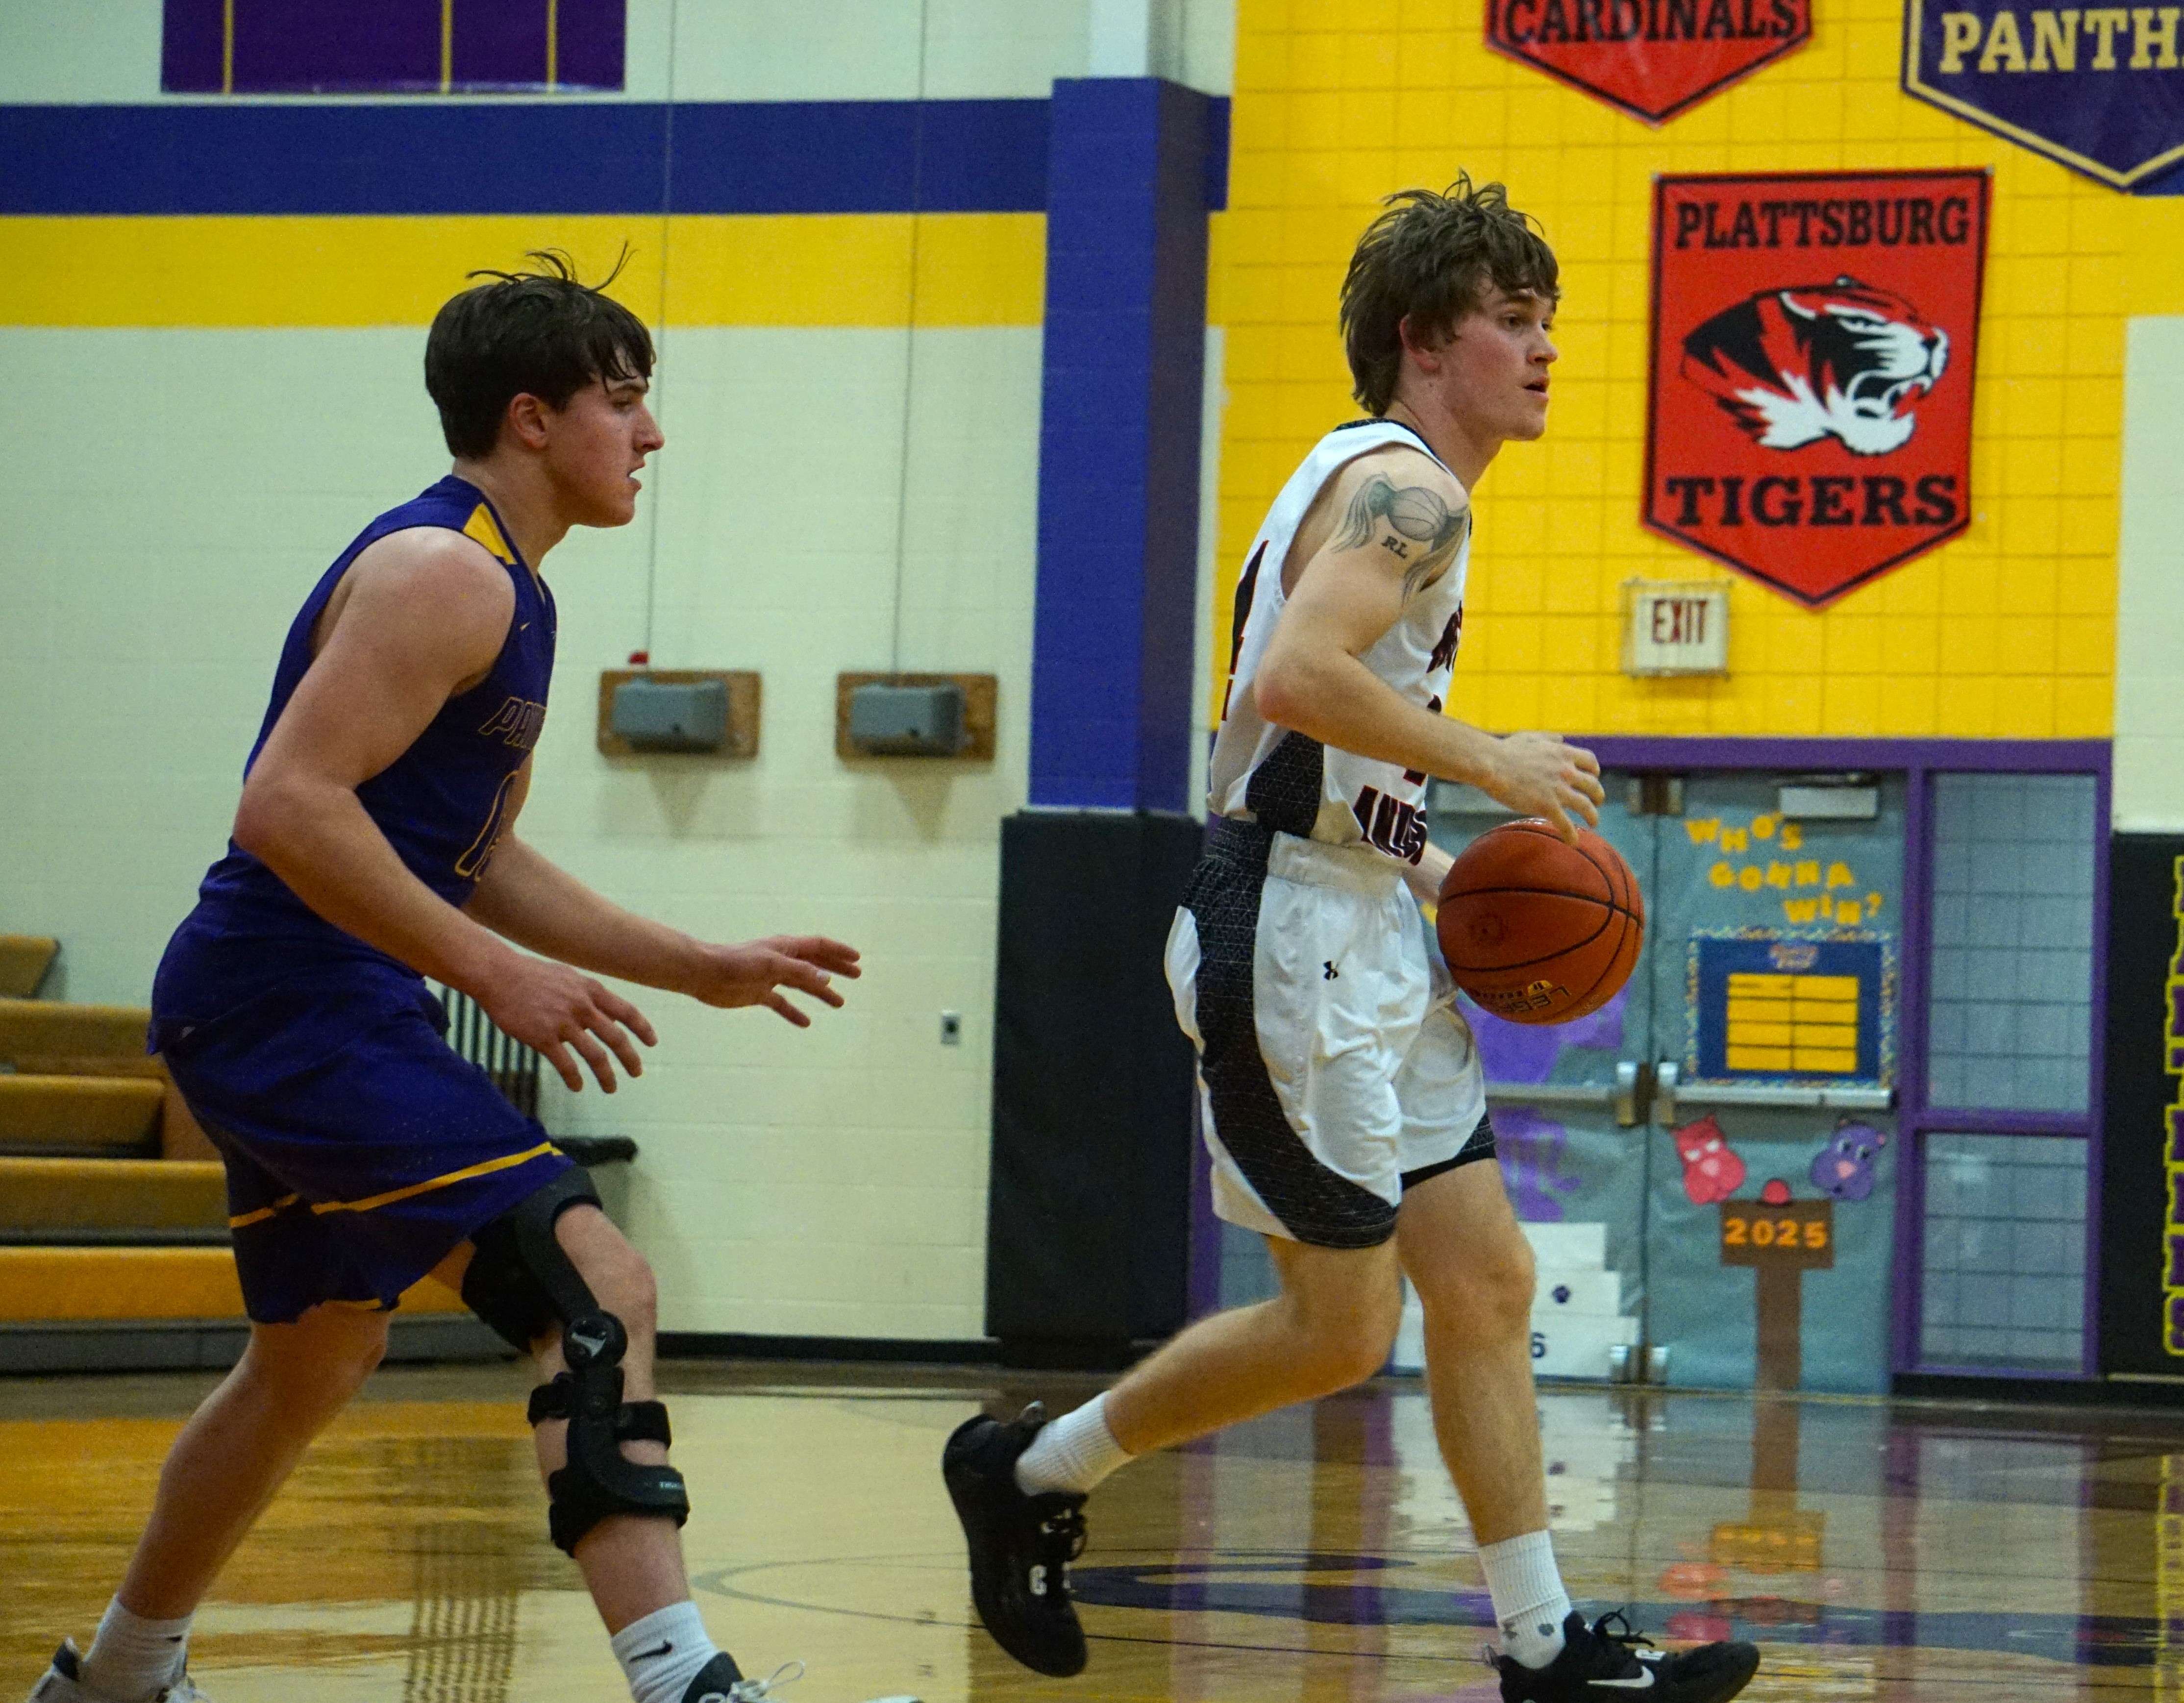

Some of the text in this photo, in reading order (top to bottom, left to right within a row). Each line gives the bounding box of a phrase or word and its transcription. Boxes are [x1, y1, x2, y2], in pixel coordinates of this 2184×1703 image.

[1505, 0, 1796, 43] CARDINALS
[1675, 197, 1968, 249] PLATTSBURG
[1667, 474, 1957, 527] TIGERS
[1381, 536, 1408, 559] RL
[1652, 598, 1709, 644] EXIT
[1684, 811, 1803, 853] WHO'S
[1708, 859, 1855, 891] GONNA
[1783, 891, 1883, 925] WIN?
[1724, 1218, 1827, 1248] 2025
